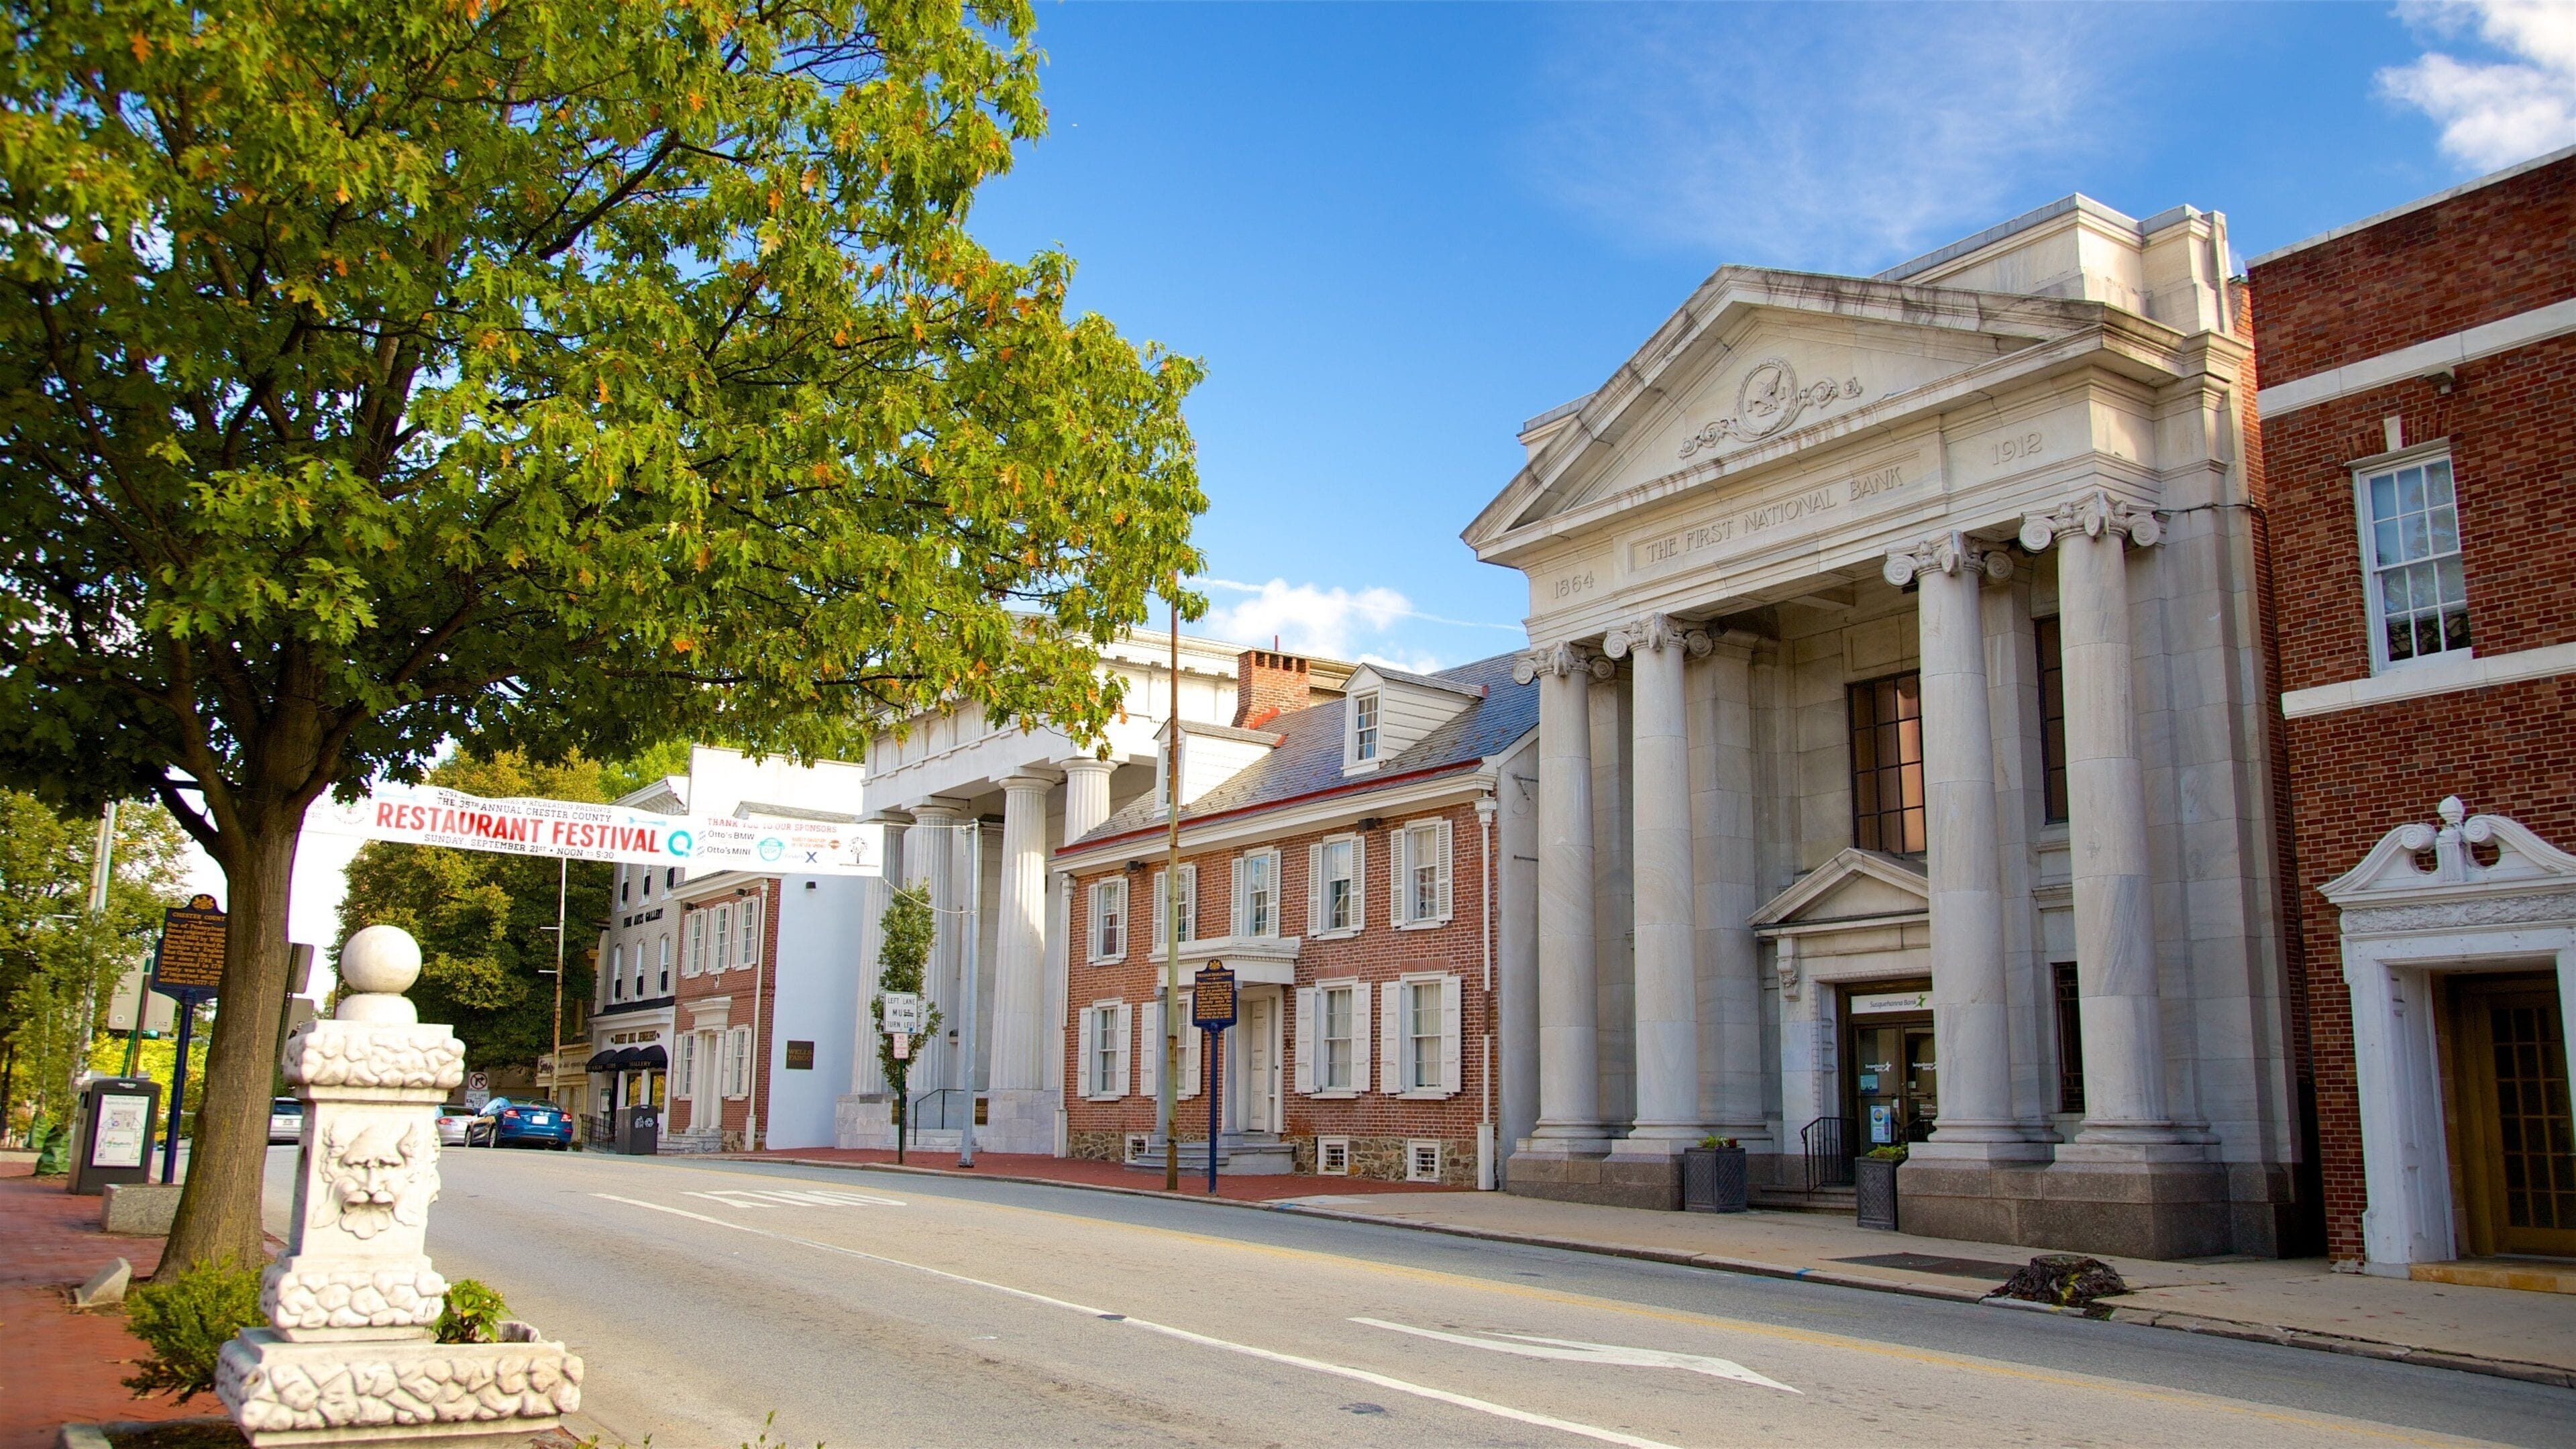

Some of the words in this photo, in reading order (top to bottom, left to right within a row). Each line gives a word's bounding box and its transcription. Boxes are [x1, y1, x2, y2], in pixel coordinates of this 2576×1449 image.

[1992, 432, 2043, 466] 1912
[1646, 537, 1678, 563] THE
[1685, 518, 1734, 552] FIRST
[1743, 488, 1837, 533] NATIONAL
[1848, 466, 1903, 502] BANK
[1554, 570, 1595, 599] 1864
[437, 797, 455, 806] THE
[480, 803, 522, 814] ANNUAL
[525, 808, 569, 819] CHESTER
[572, 812, 612, 822] COUNTY
[576, 804, 612, 814] PRESENTS
[376, 802, 543, 843] RESTAURANT
[552, 821, 660, 853] FESTIVAL
[707, 818, 738, 828] THANK
[775, 822, 792, 830] OUR
[794, 824, 837, 833] SPONSORS
[734, 832, 755, 840] BMW
[471, 839, 526, 852] SEPTEMBER
[557, 848, 583, 857] NOON
[596, 851, 614, 859] 5:30
[707, 846, 731, 855] Otto's
[172, 912, 201, 920] CHESTER
[1870, 1000, 1902, 1008] Susquehanna
